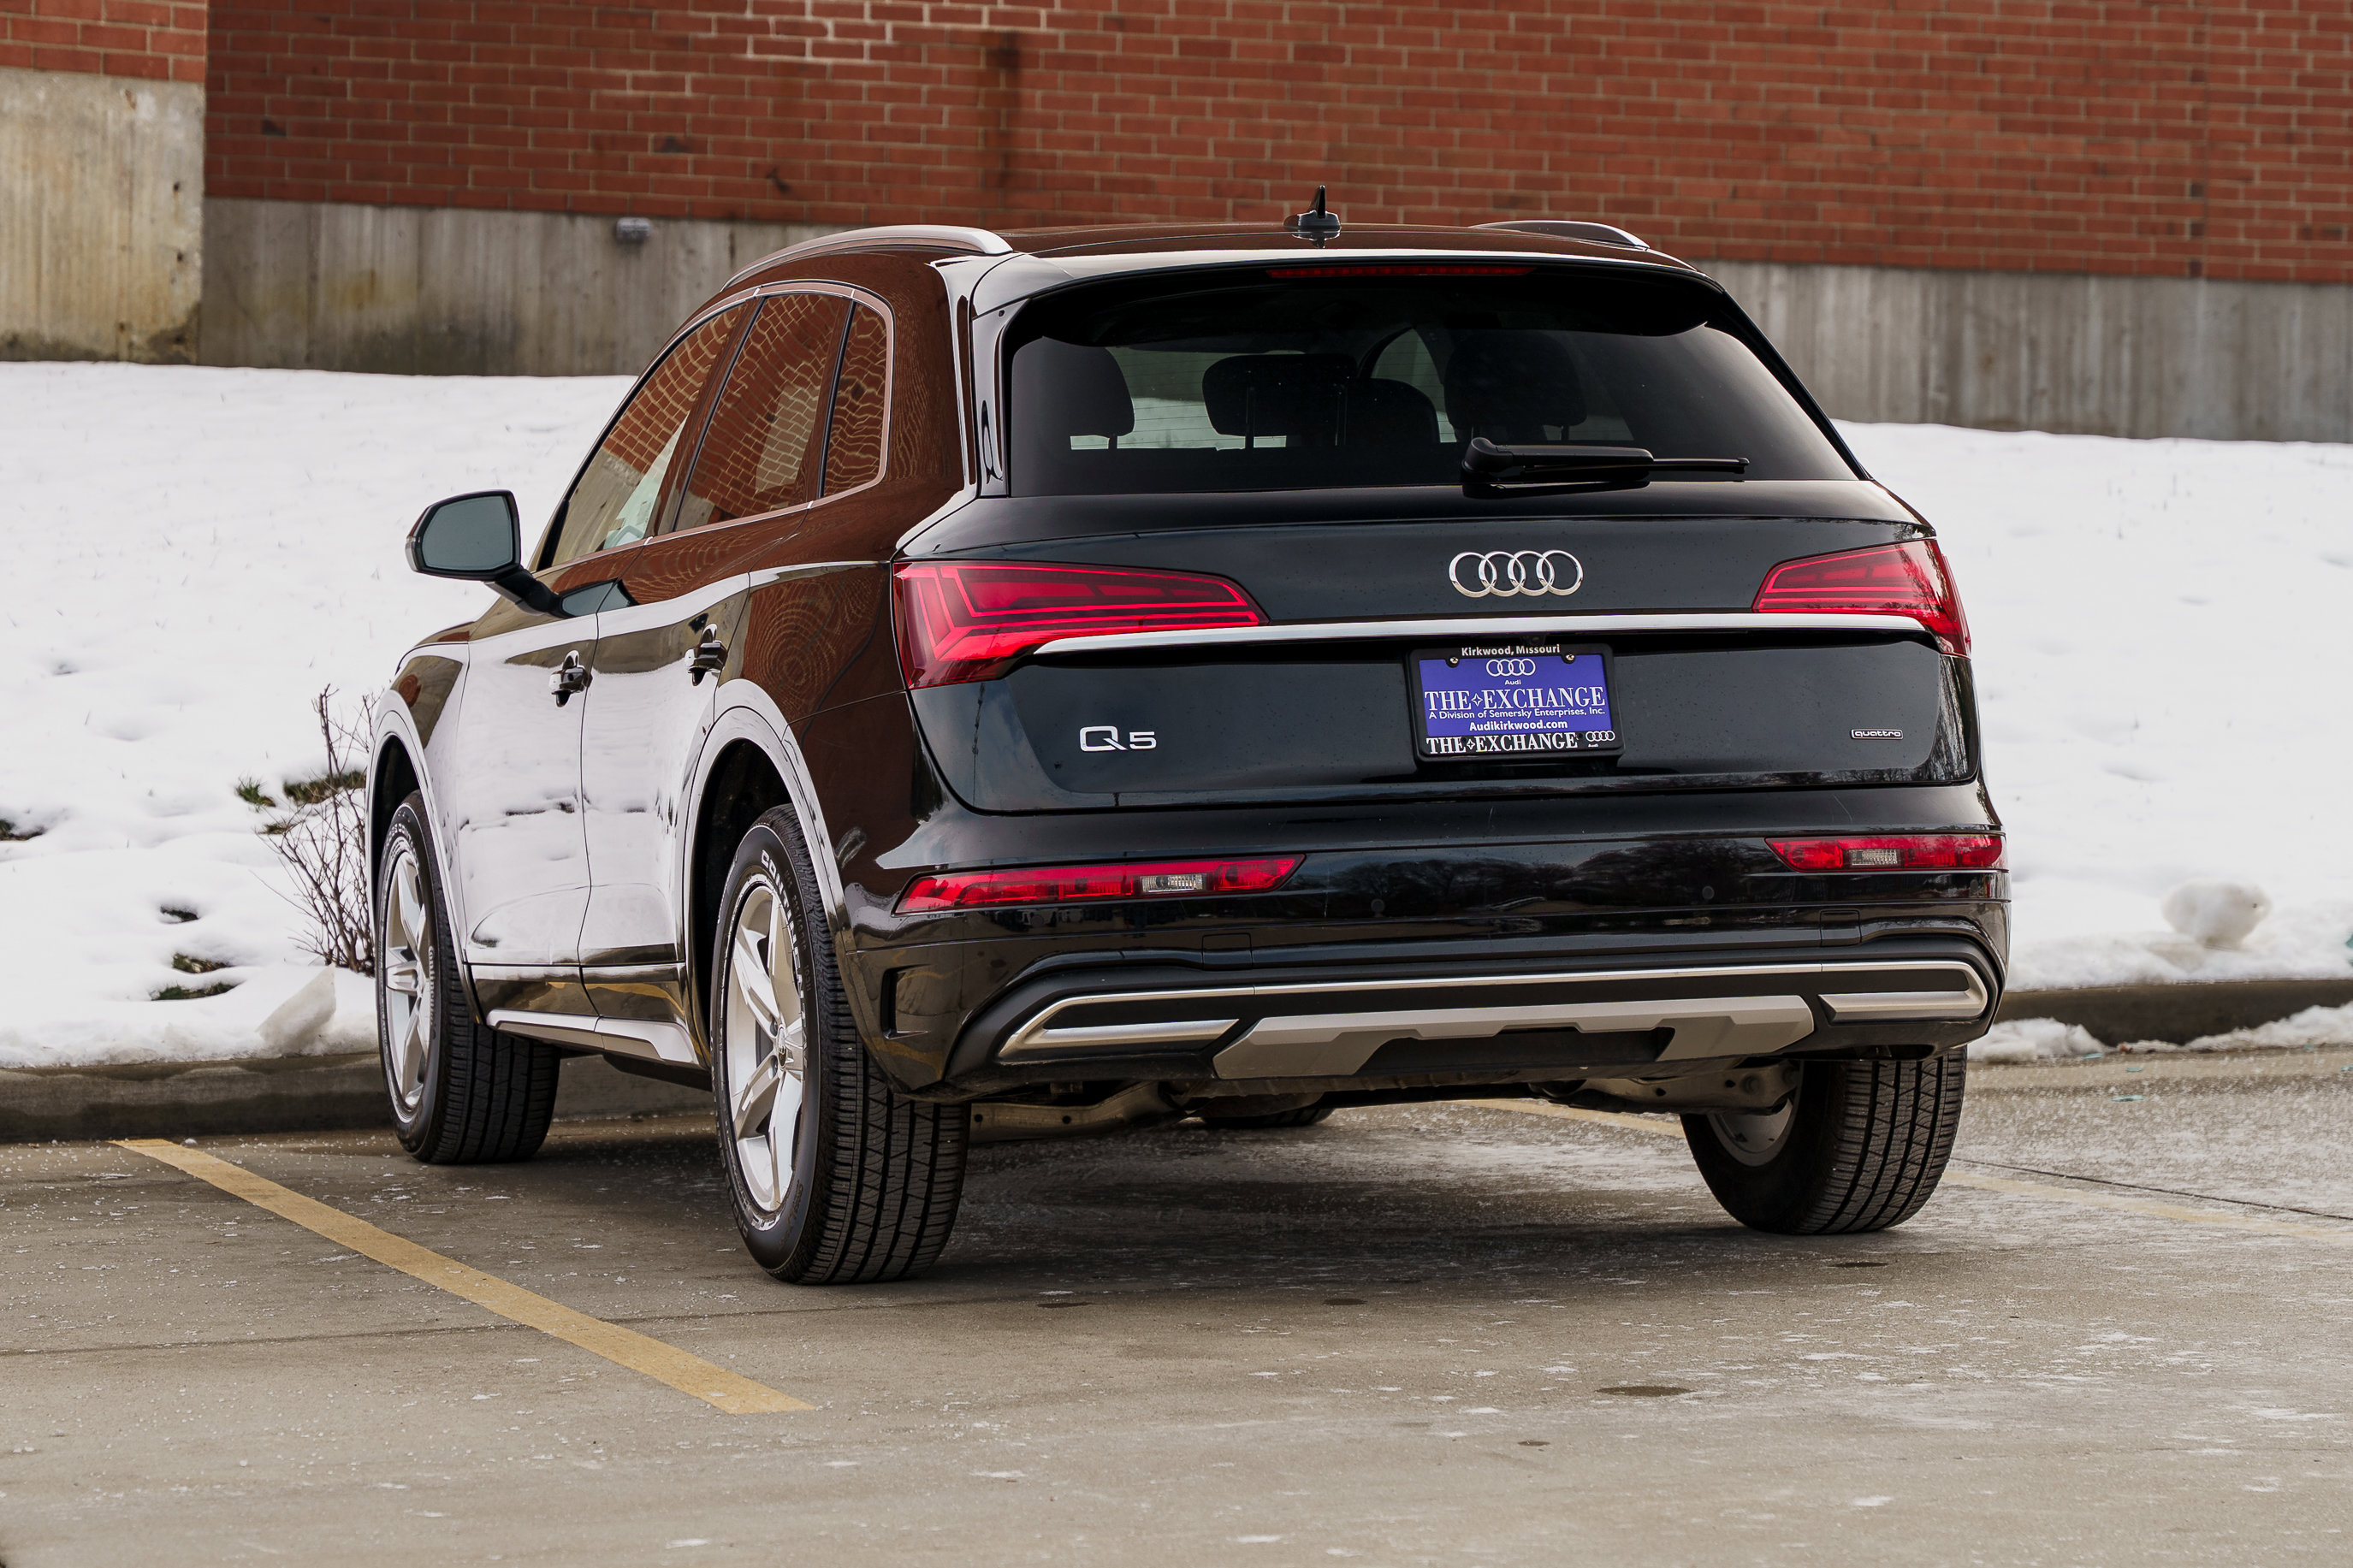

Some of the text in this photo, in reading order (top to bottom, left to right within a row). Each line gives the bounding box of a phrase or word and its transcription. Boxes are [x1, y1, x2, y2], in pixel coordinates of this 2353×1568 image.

[1461, 643, 1561, 657] Kirkwood, Missouri
[1424, 686, 1606, 711] THE EXCHANGE
[1429, 707, 1605, 719] A Division of Semersky Enterprises, Inc.
[1468, 719, 1568, 732] Audikirkwood.com
[1079, 725, 1157, 752] Q5
[1425, 731, 1579, 754] THE EXCHANGE
